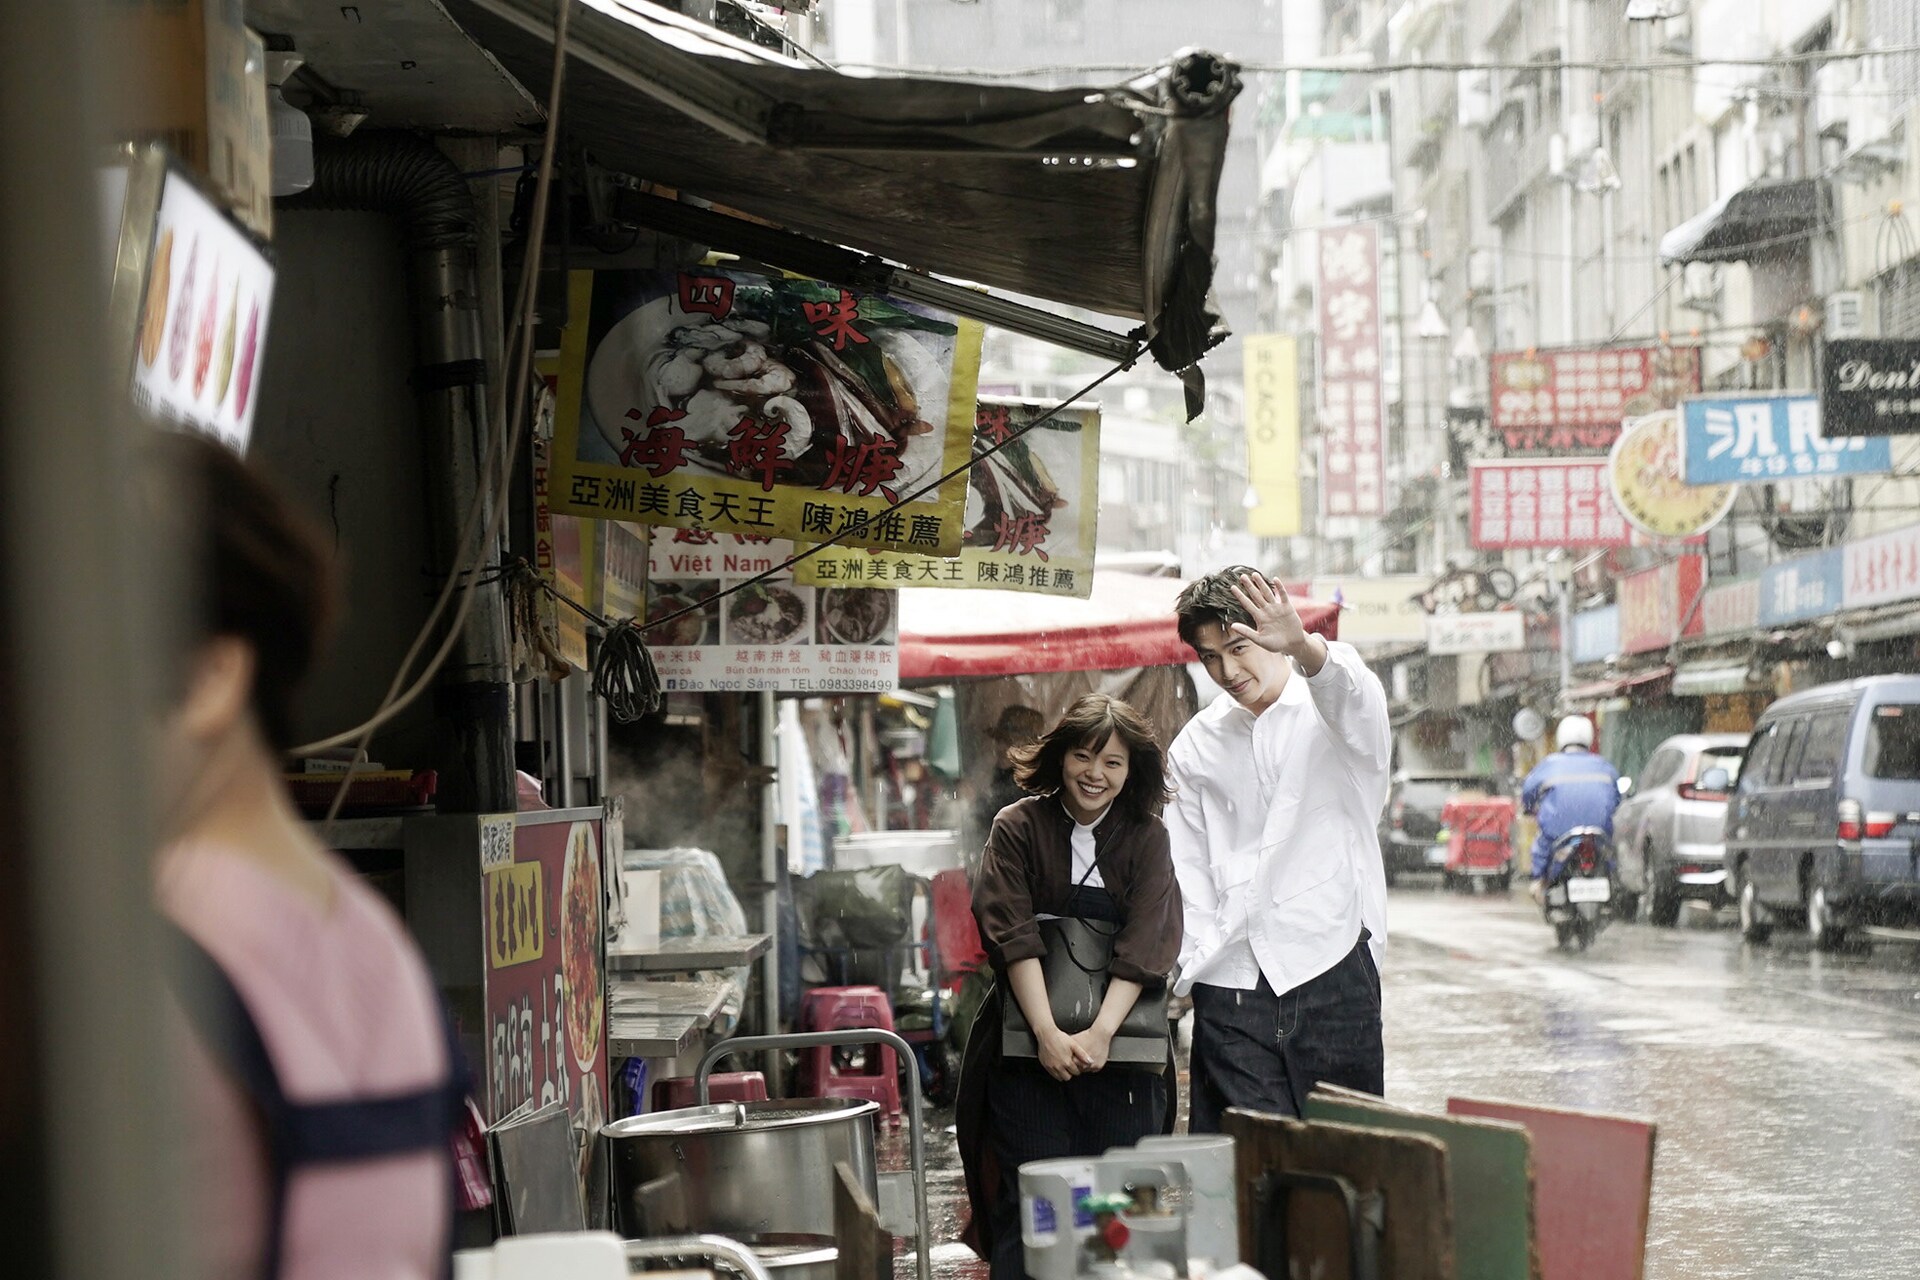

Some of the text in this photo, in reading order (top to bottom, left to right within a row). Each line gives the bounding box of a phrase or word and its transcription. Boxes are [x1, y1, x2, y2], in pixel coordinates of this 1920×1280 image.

[678, 272, 870, 350] 四味
[568, 474, 942, 549] 亞洲美食天王 陳鴻推薦
[669, 554, 712, 576] Việt
[724, 555, 771, 572] Nam
[816, 558, 964, 582] 亞洲美食天王
[977, 561, 1074, 590] 陳鴻推薦
